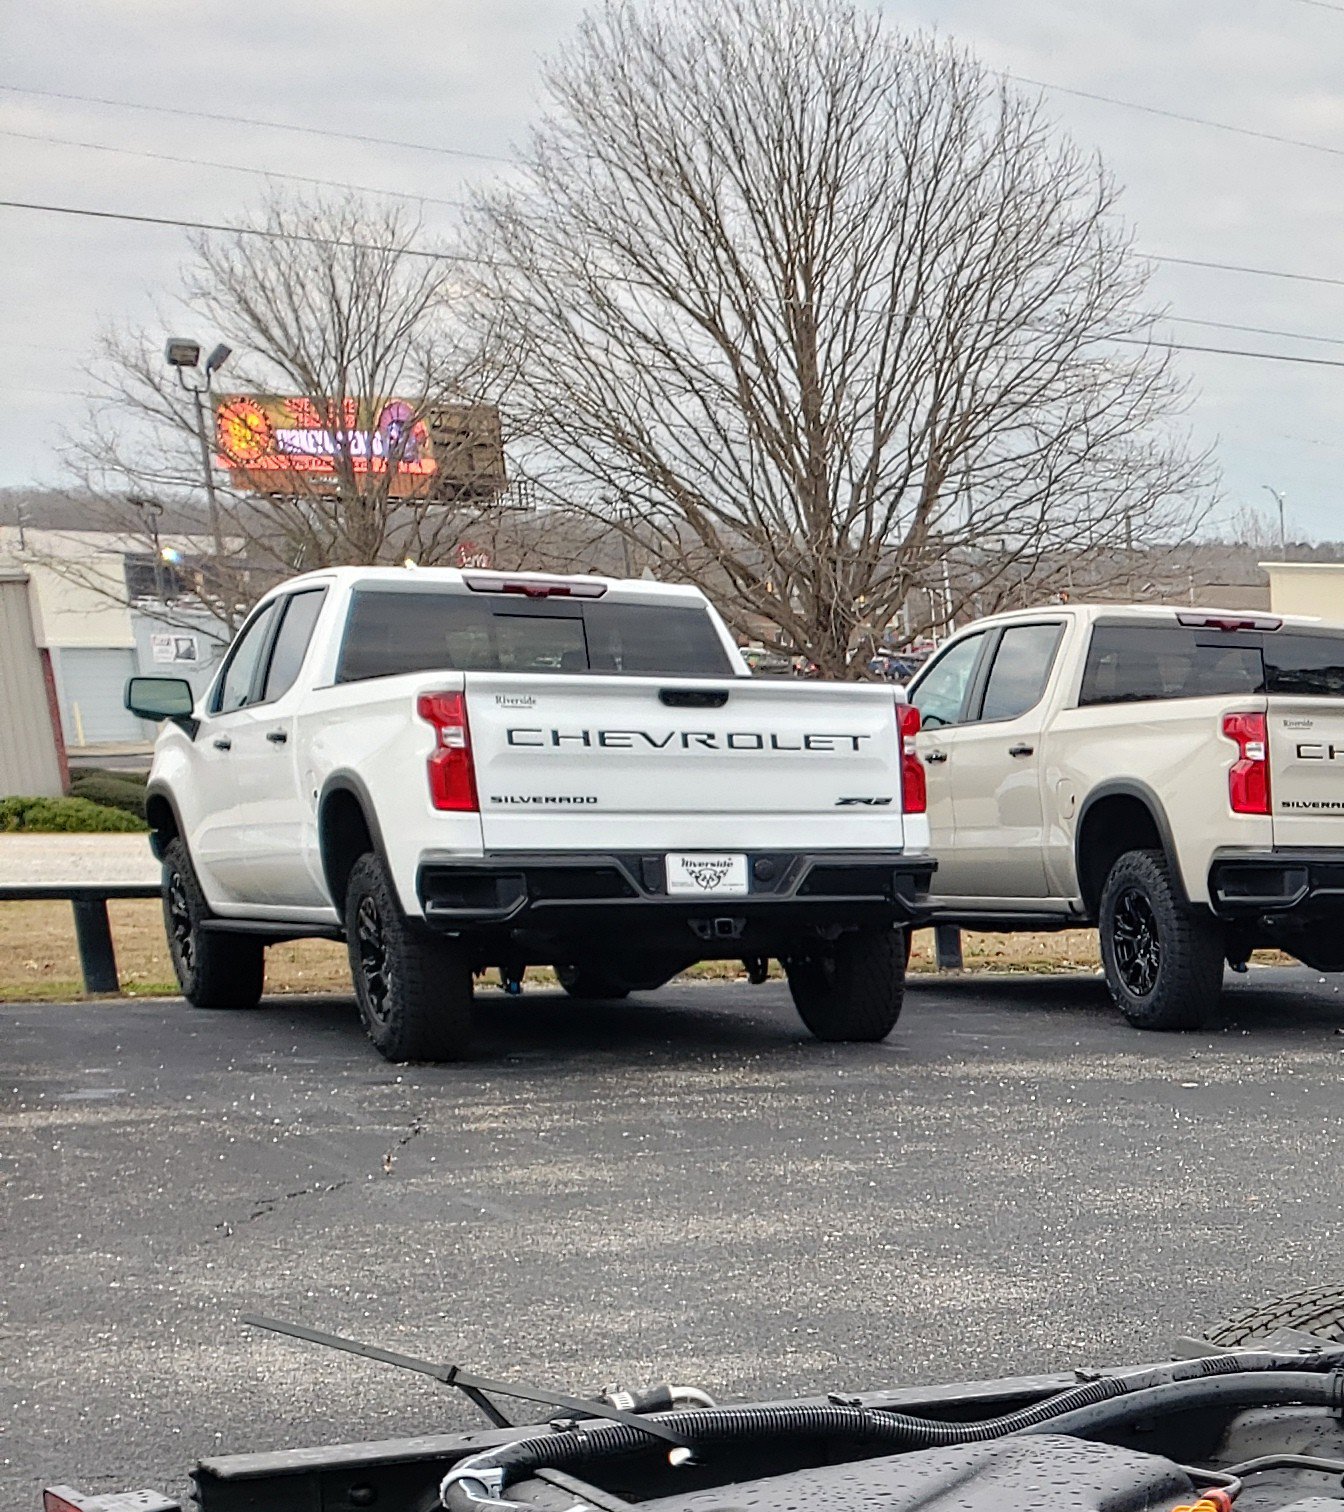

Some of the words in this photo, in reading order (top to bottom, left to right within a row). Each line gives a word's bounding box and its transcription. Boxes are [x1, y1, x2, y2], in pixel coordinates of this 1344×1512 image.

[495, 694, 537, 704] Riverside
[506, 728, 871, 752] CHEVROLET
[490, 795, 599, 805] SILVERADO
[834, 797, 893, 806] ZR2
